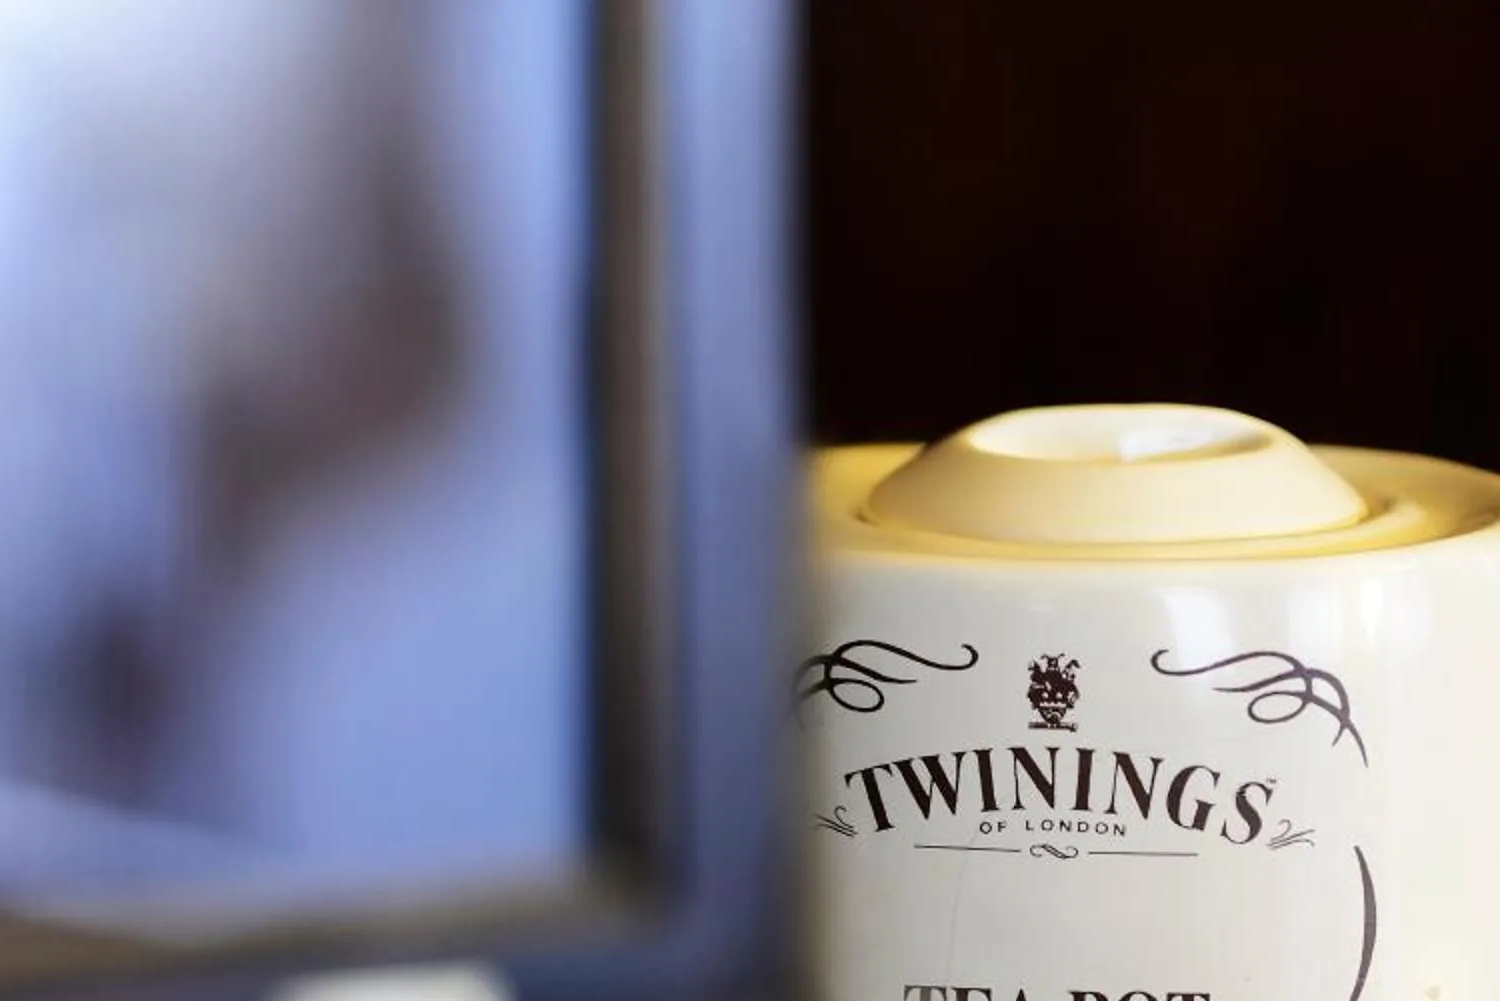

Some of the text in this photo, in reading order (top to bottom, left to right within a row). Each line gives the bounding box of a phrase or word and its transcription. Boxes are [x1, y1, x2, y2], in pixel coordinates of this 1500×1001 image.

[844, 746, 1274, 845] TWININGS
[979, 819, 1127, 837] OF LONDON
